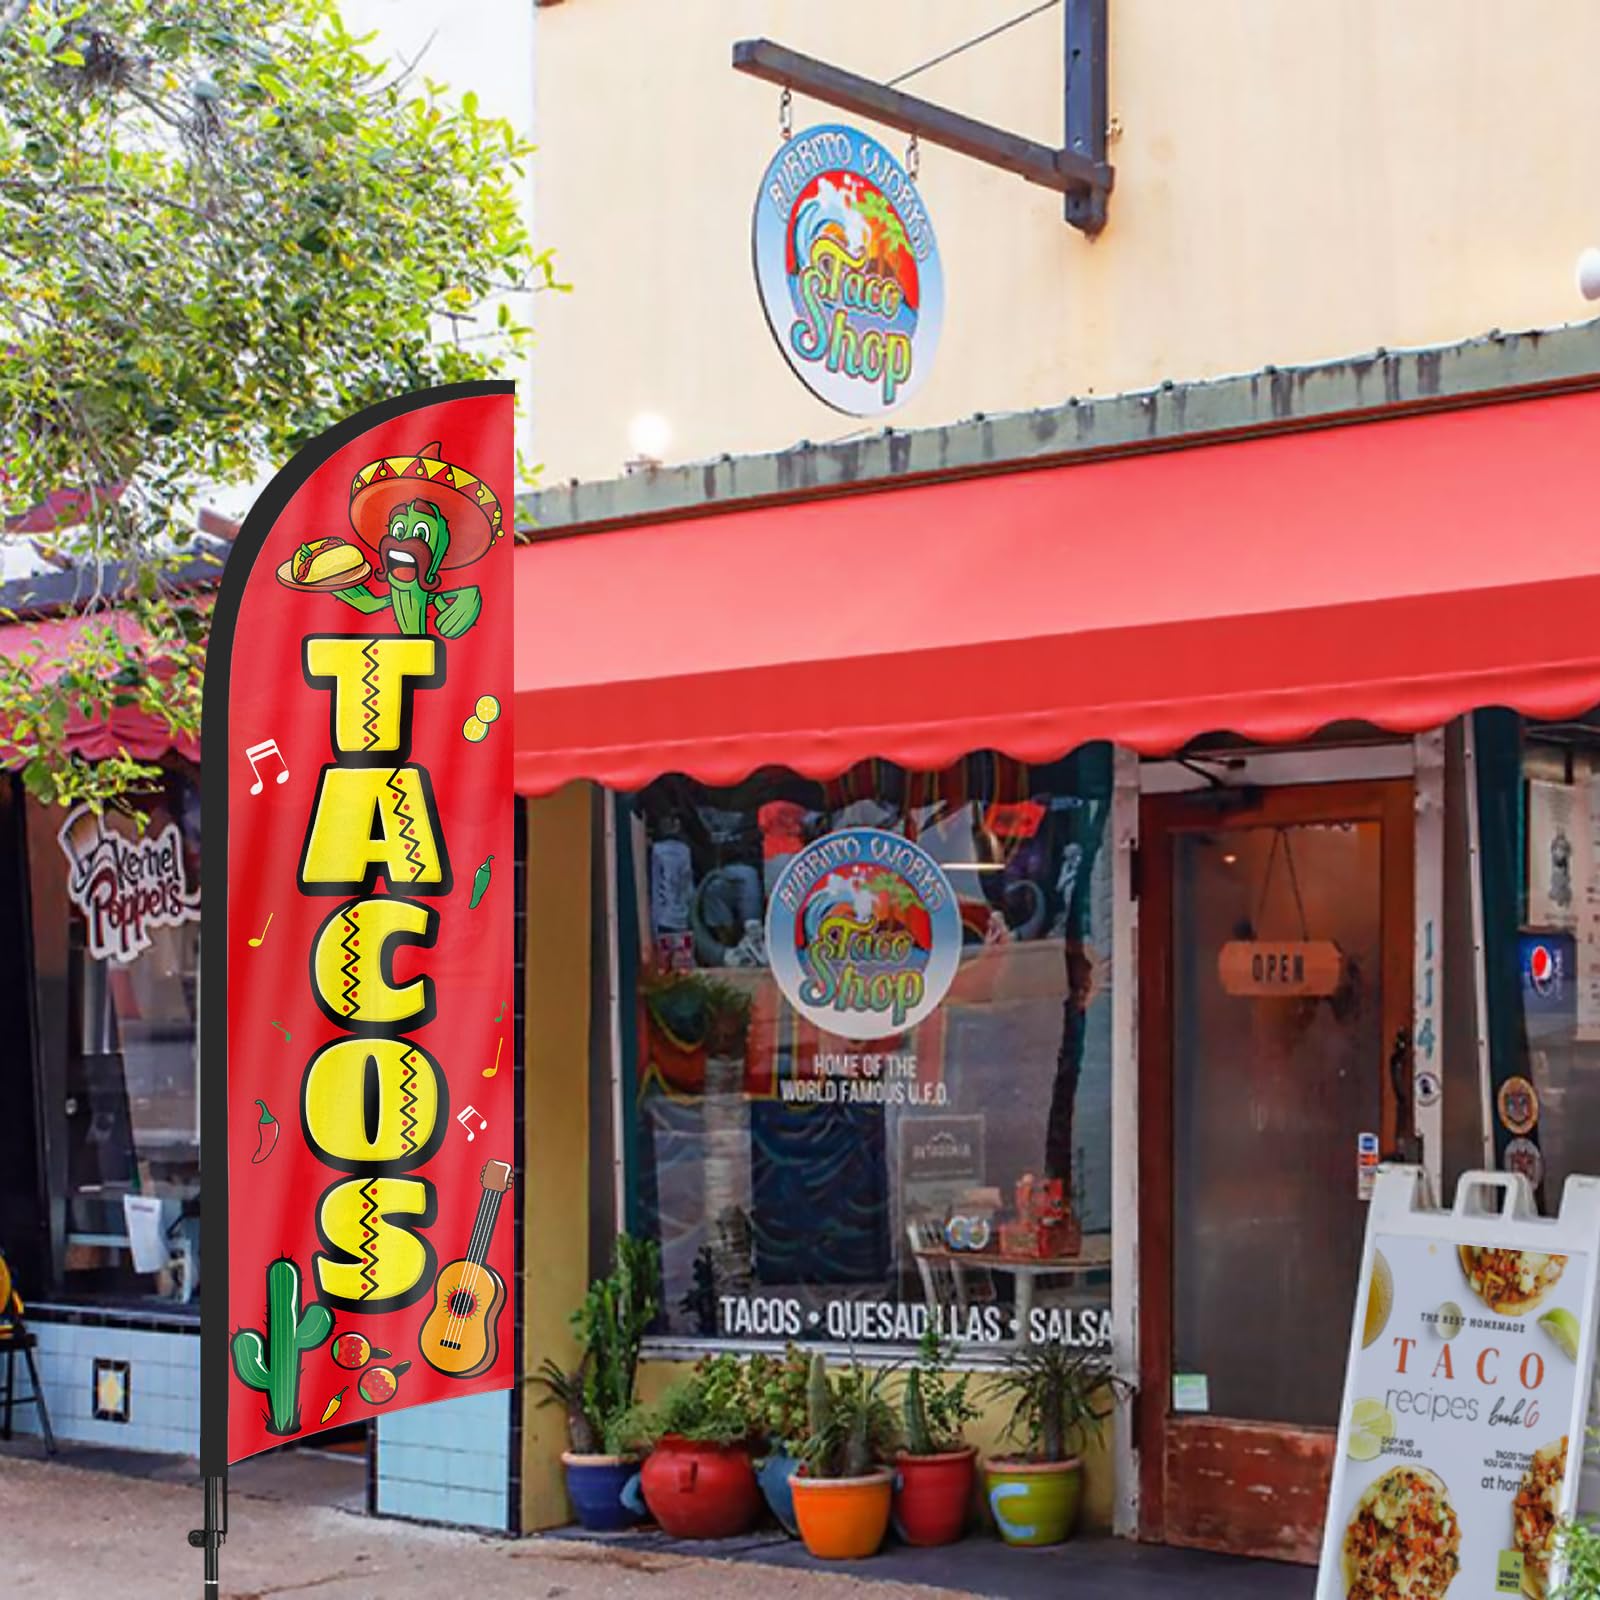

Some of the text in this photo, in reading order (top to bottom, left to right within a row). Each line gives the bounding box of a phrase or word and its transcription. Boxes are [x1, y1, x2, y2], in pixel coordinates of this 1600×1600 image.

[810, 236, 901, 318] Taco
[790, 265, 912, 405] Shop
[819, 914, 913, 961] Taco
[300, 633, 446, 1308] TACOS
[799, 940, 925, 1026] Shop
[1252, 953, 1304, 982] OPEN
[814, 1053, 918, 1079] HOME OF THE
[780, 1079, 836, 1102] WORLD
[840, 1080, 905, 1104] FAMOUS
[720, 1297, 1113, 1347] TACOS QUESADLLAS SALSA
[1420, 1312, 1526, 1334] THE BEST HOMEMADE
[1393, 1337, 1545, 1391] TACO
[1385, 1388, 1479, 1423] recipes
[1481, 1476, 1494, 1489] at
